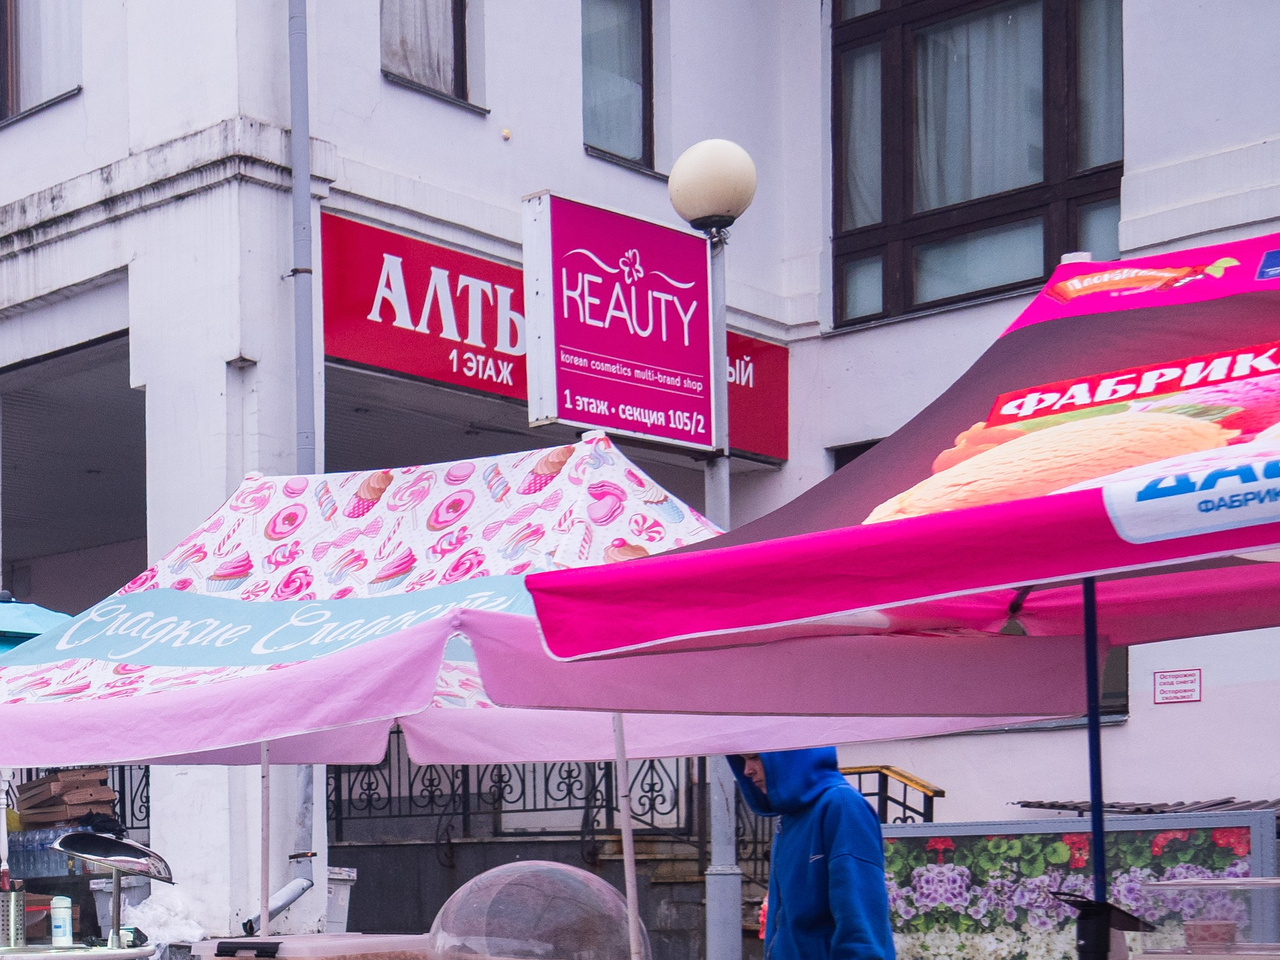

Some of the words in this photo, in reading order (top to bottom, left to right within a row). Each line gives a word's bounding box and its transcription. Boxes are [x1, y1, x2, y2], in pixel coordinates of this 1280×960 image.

[562, 266, 698, 347] KEAUTY
[448, 348, 459, 373] 1
[462, 351, 514, 387] ЭТАЖ
[560, 350, 589, 368] korean
[590, 359, 632, 377] cosmetics
[634, 369, 681, 388] multi-brand
[683, 377, 704, 393] shop
[1000, 347, 1280, 418] ФАБРИК
[563, 388, 573, 409] 1
[574, 395, 610, 416] этаж
[618, 404, 666, 428] секция
[668, 409, 706, 436] 105/2
